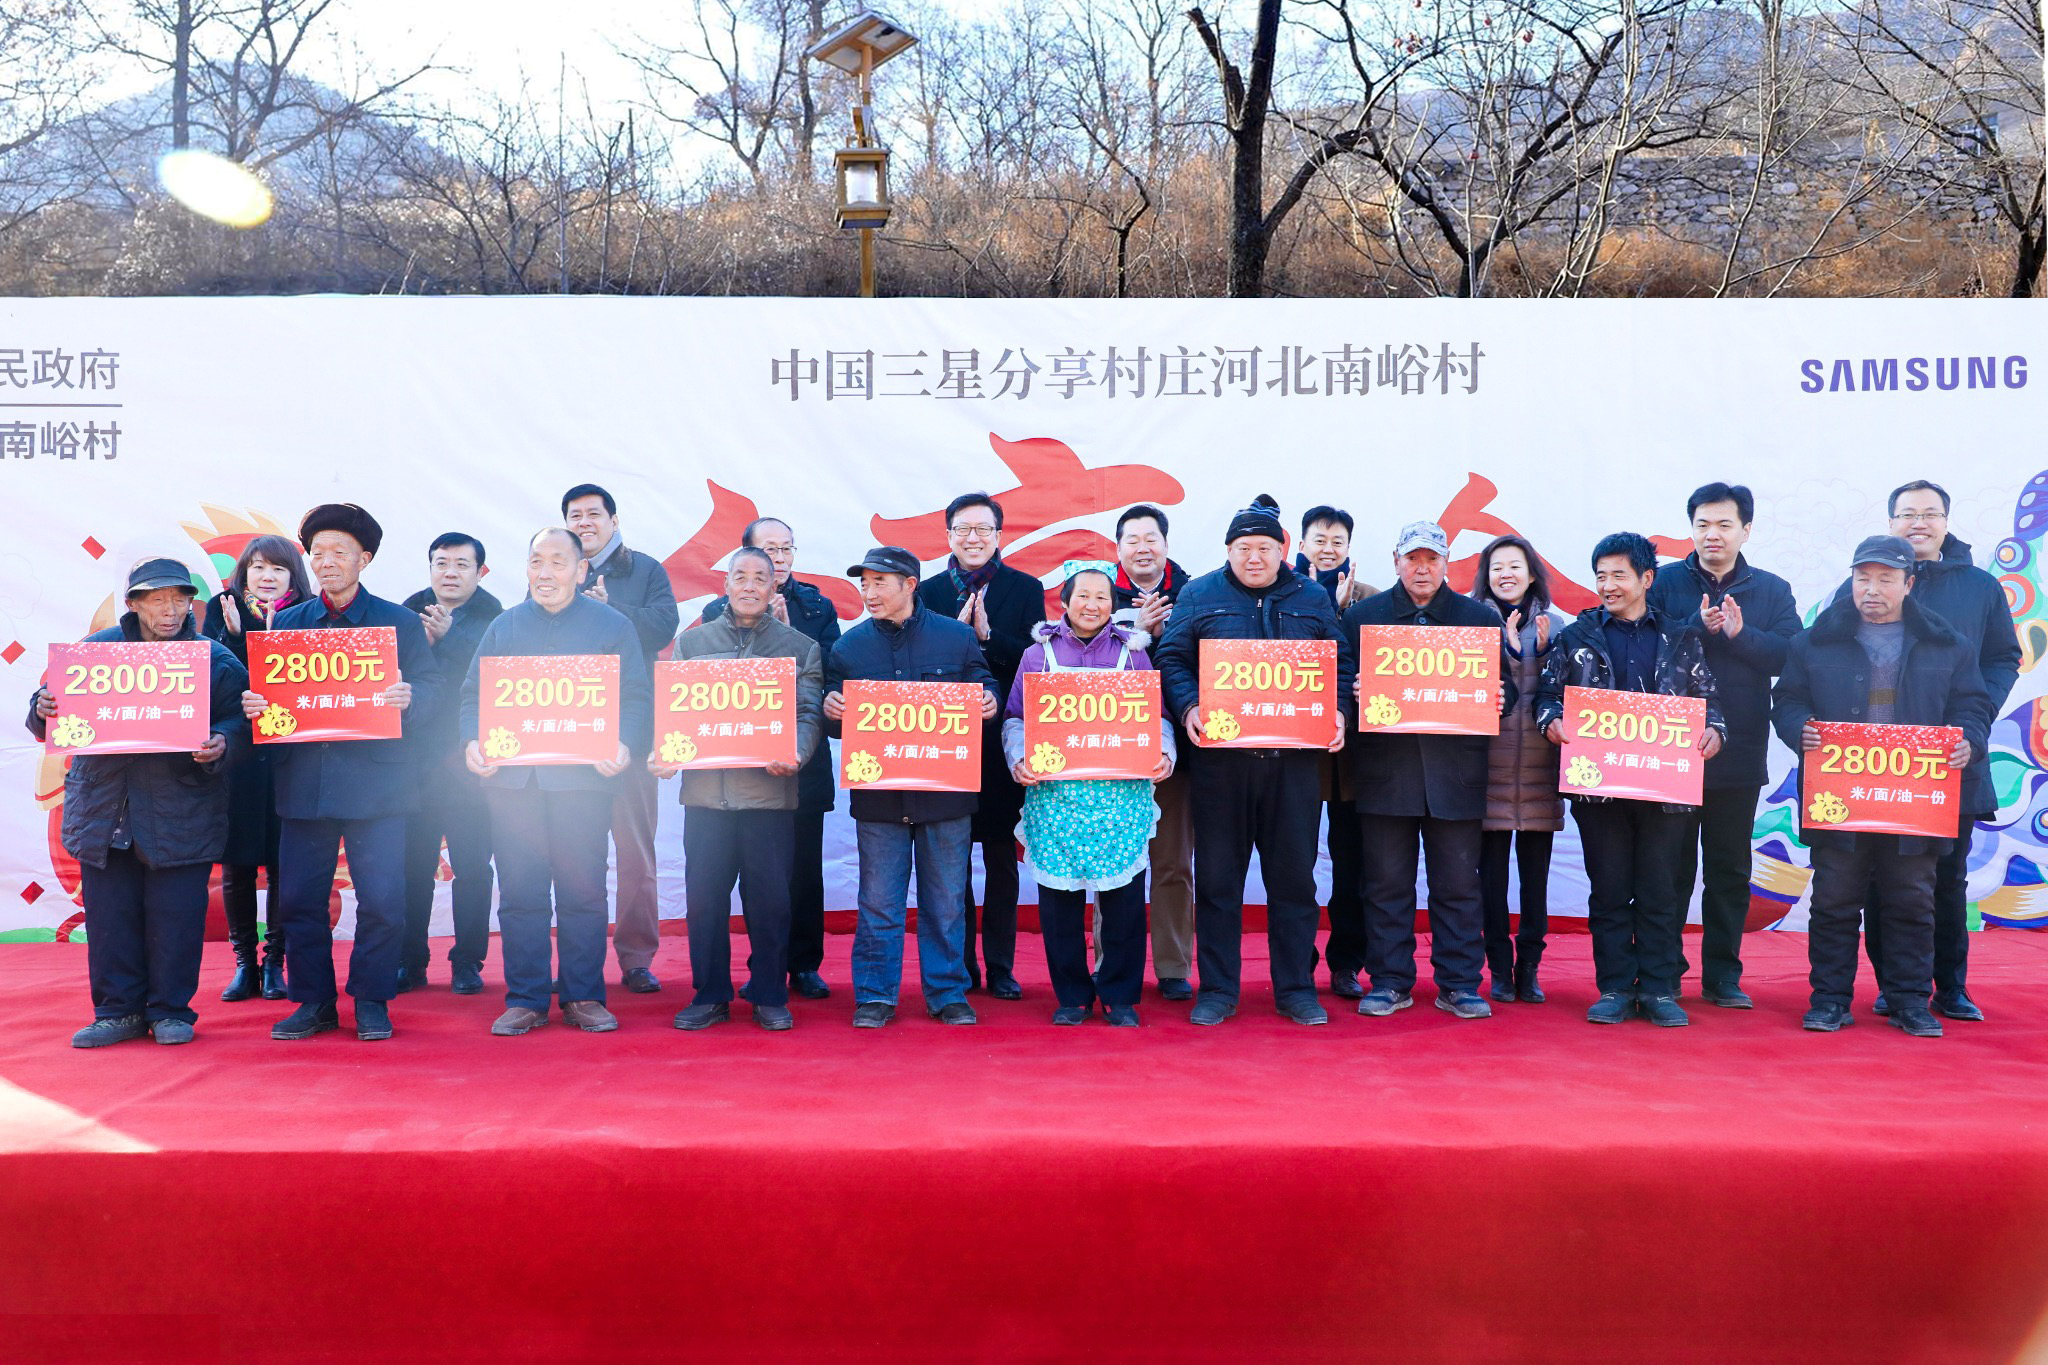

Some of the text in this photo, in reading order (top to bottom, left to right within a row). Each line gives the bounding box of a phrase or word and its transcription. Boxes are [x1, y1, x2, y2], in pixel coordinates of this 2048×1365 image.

[772, 342, 1486, 401] 中国三星分享村庄河北南峪村
[1800, 355, 2028, 393] SAMSUNG
[0, 420, 122, 460] 南峪村
[265, 650, 385, 684] 2800元
[1213, 661, 1325, 692] 2800元
[1374, 646, 1489, 679] 2800元
[64, 664, 196, 695] 2800元
[494, 677, 607, 708] 2800元
[669, 680, 784, 712] 2800元
[1038, 693, 1151, 724] 2800元
[1240, 702, 1324, 717] 米/面/油一份
[1402, 688, 1488, 703] 米/面/油一份
[96, 704, 195, 720] 米/面/油一份
[521, 718, 606, 733] 米/面/油一份
[856, 702, 970, 735] 2800元
[697, 720, 783, 737] 米/面/油一份
[1066, 733, 1151, 748] 米/面/油一份
[1577, 709, 1692, 749] 2800元
[883, 744, 969, 760] 米/面/油一份
[1603, 752, 1691, 773] 米/面/油一份
[1820, 744, 1948, 780] 2800元
[1850, 786, 1946, 805] 米/面/油一份
